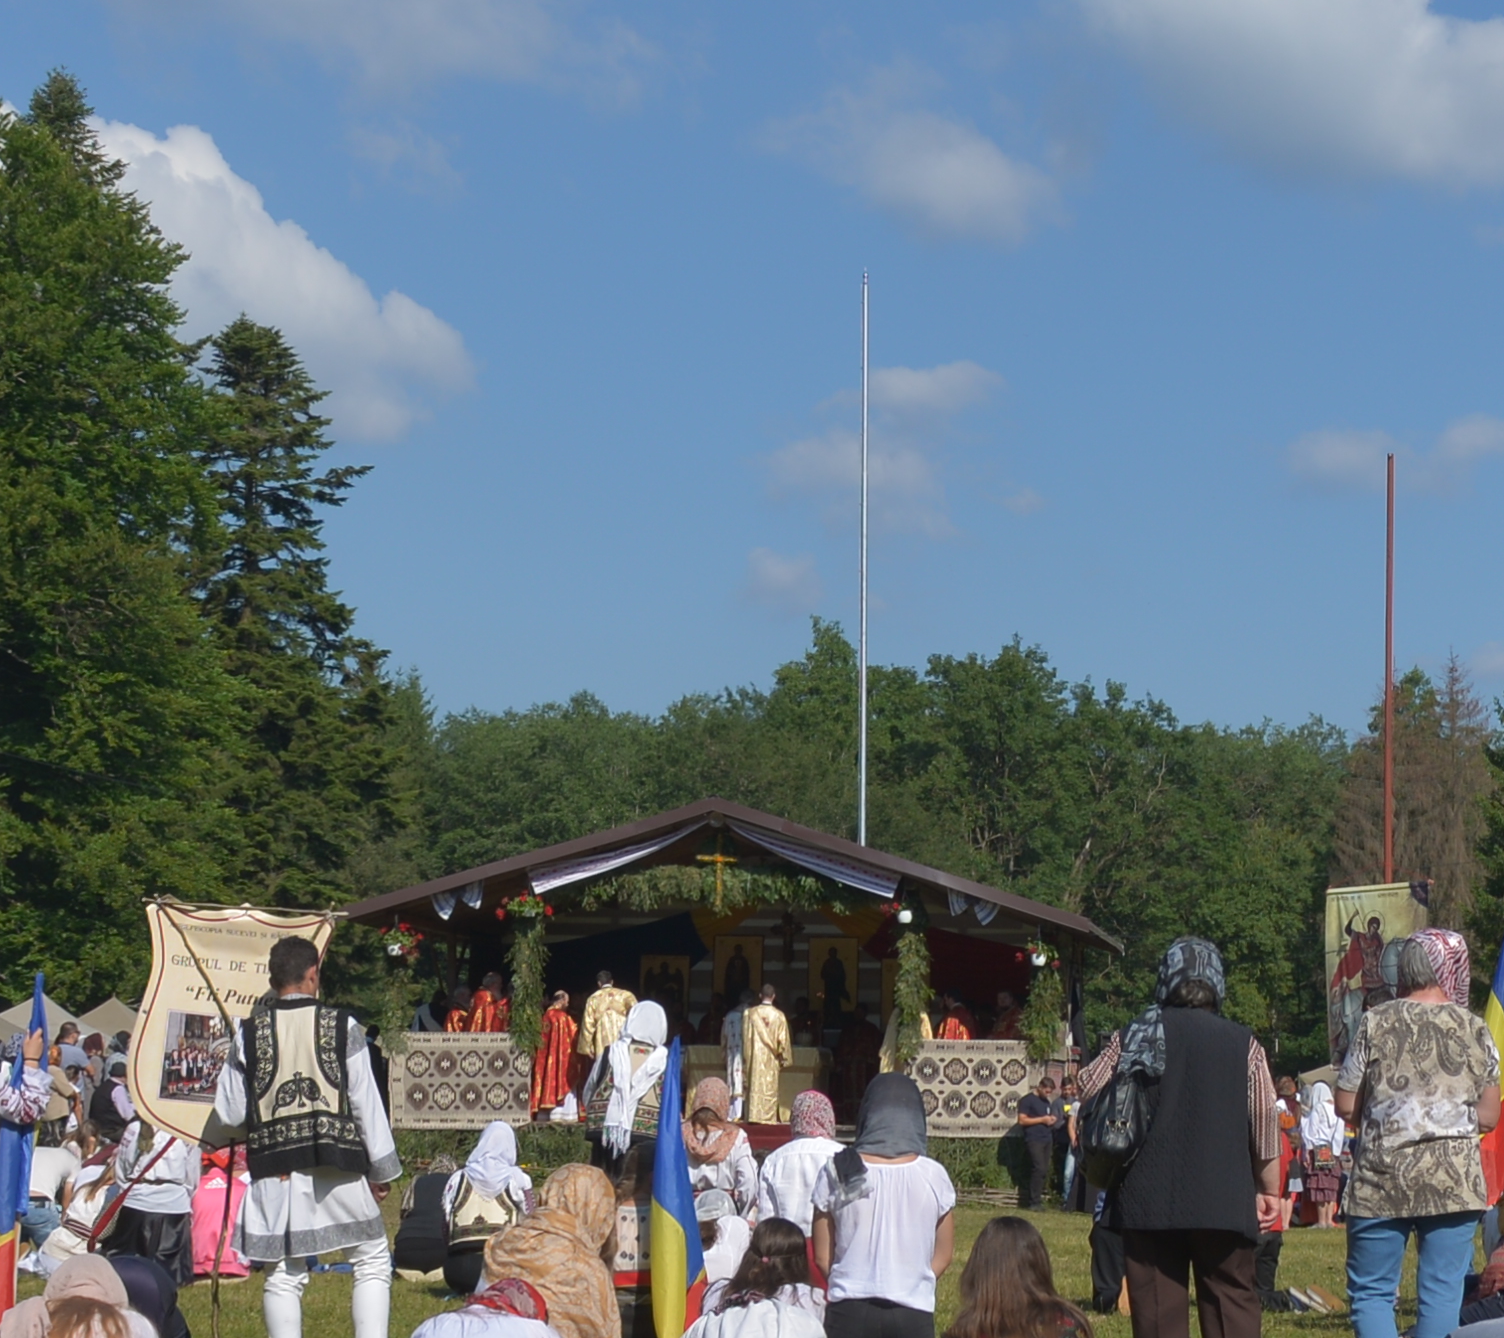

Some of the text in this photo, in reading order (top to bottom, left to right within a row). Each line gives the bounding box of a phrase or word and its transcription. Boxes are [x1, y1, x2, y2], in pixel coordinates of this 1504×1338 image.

[171, 954, 222, 970] GRUPUL
[229, 960, 247, 972] DE
[223, 988, 275, 1007] Putne
